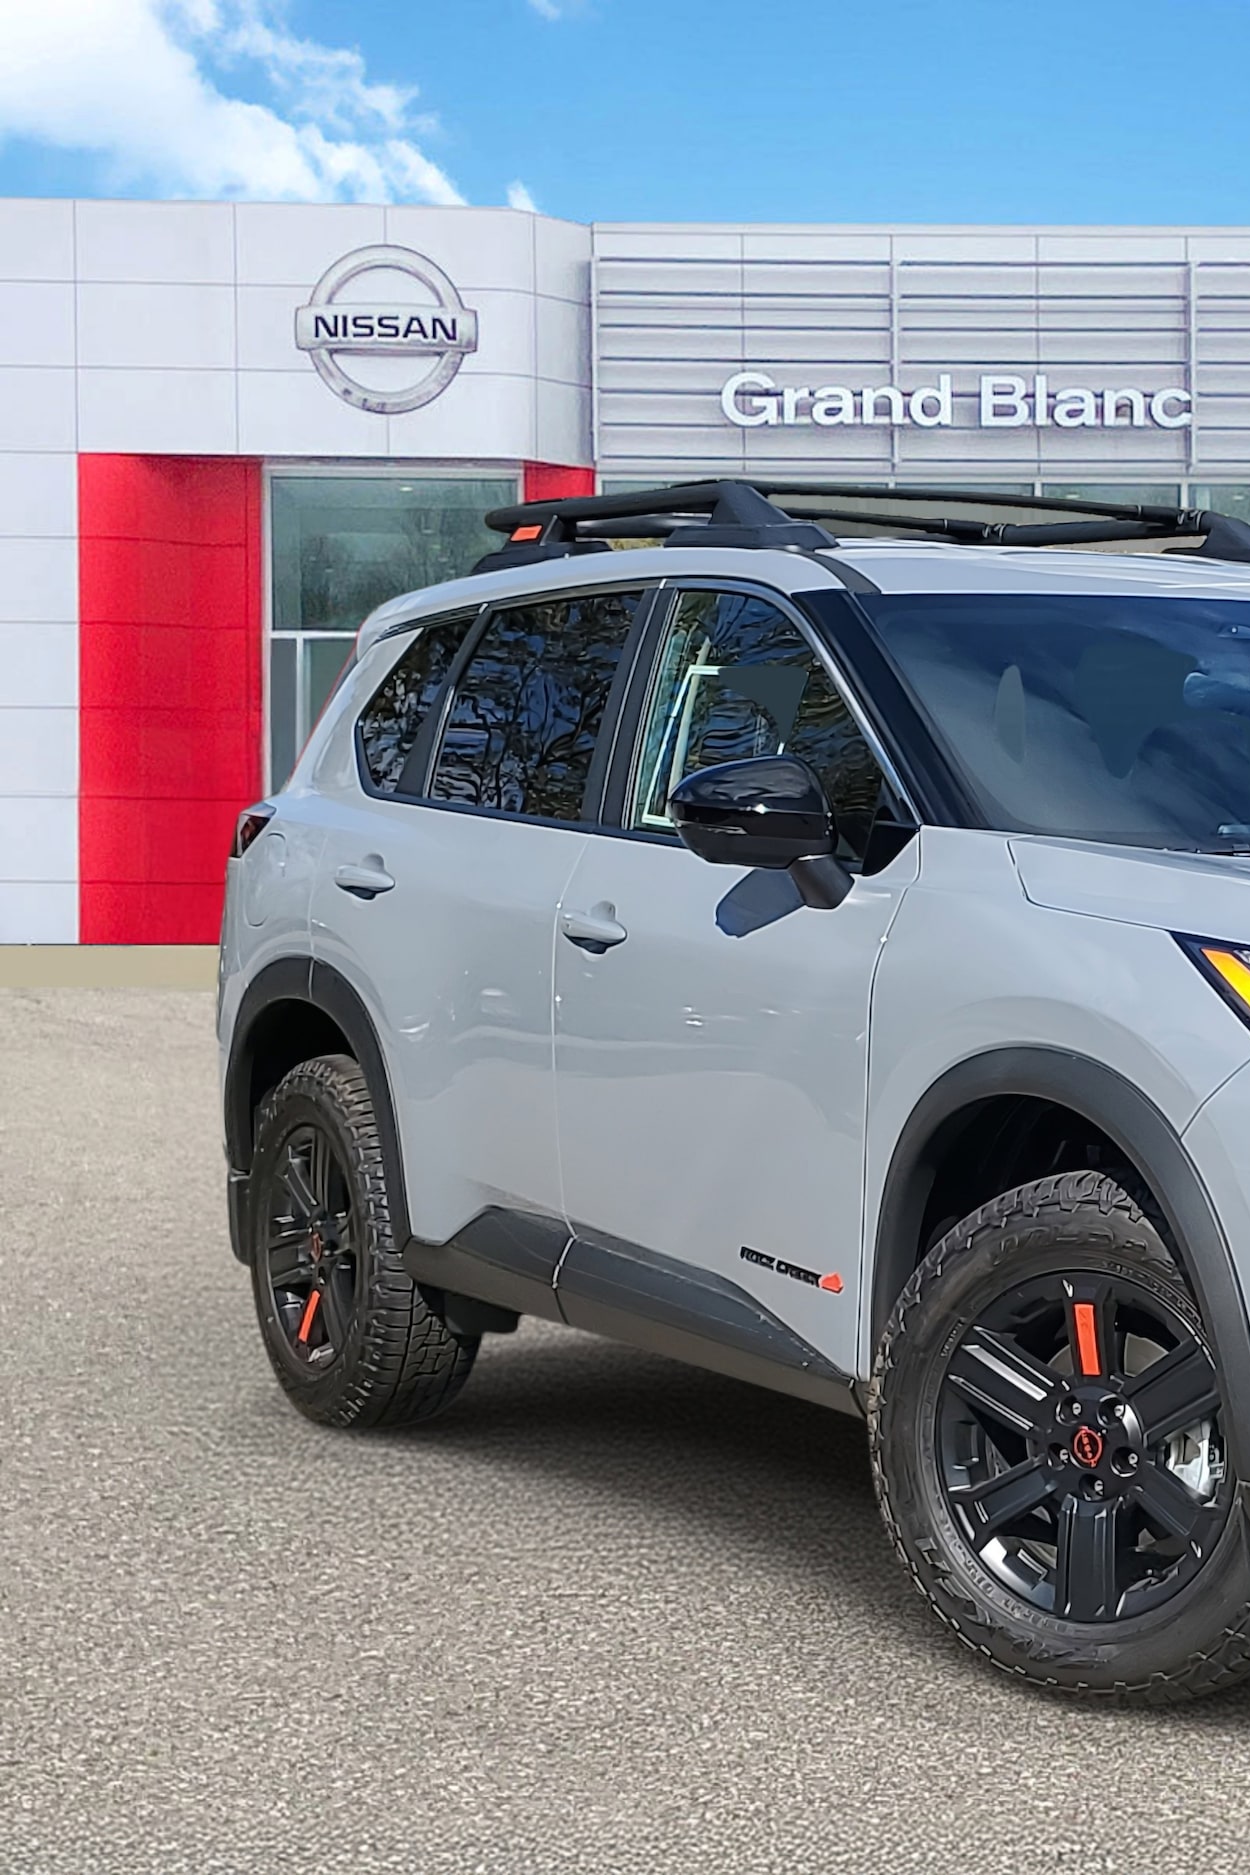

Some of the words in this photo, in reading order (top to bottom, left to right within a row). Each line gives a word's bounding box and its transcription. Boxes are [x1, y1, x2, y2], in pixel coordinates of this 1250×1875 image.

[314, 315, 457, 341] NISSAN
[721, 373, 952, 427] Grand
[979, 374, 1194, 428] Blanc
